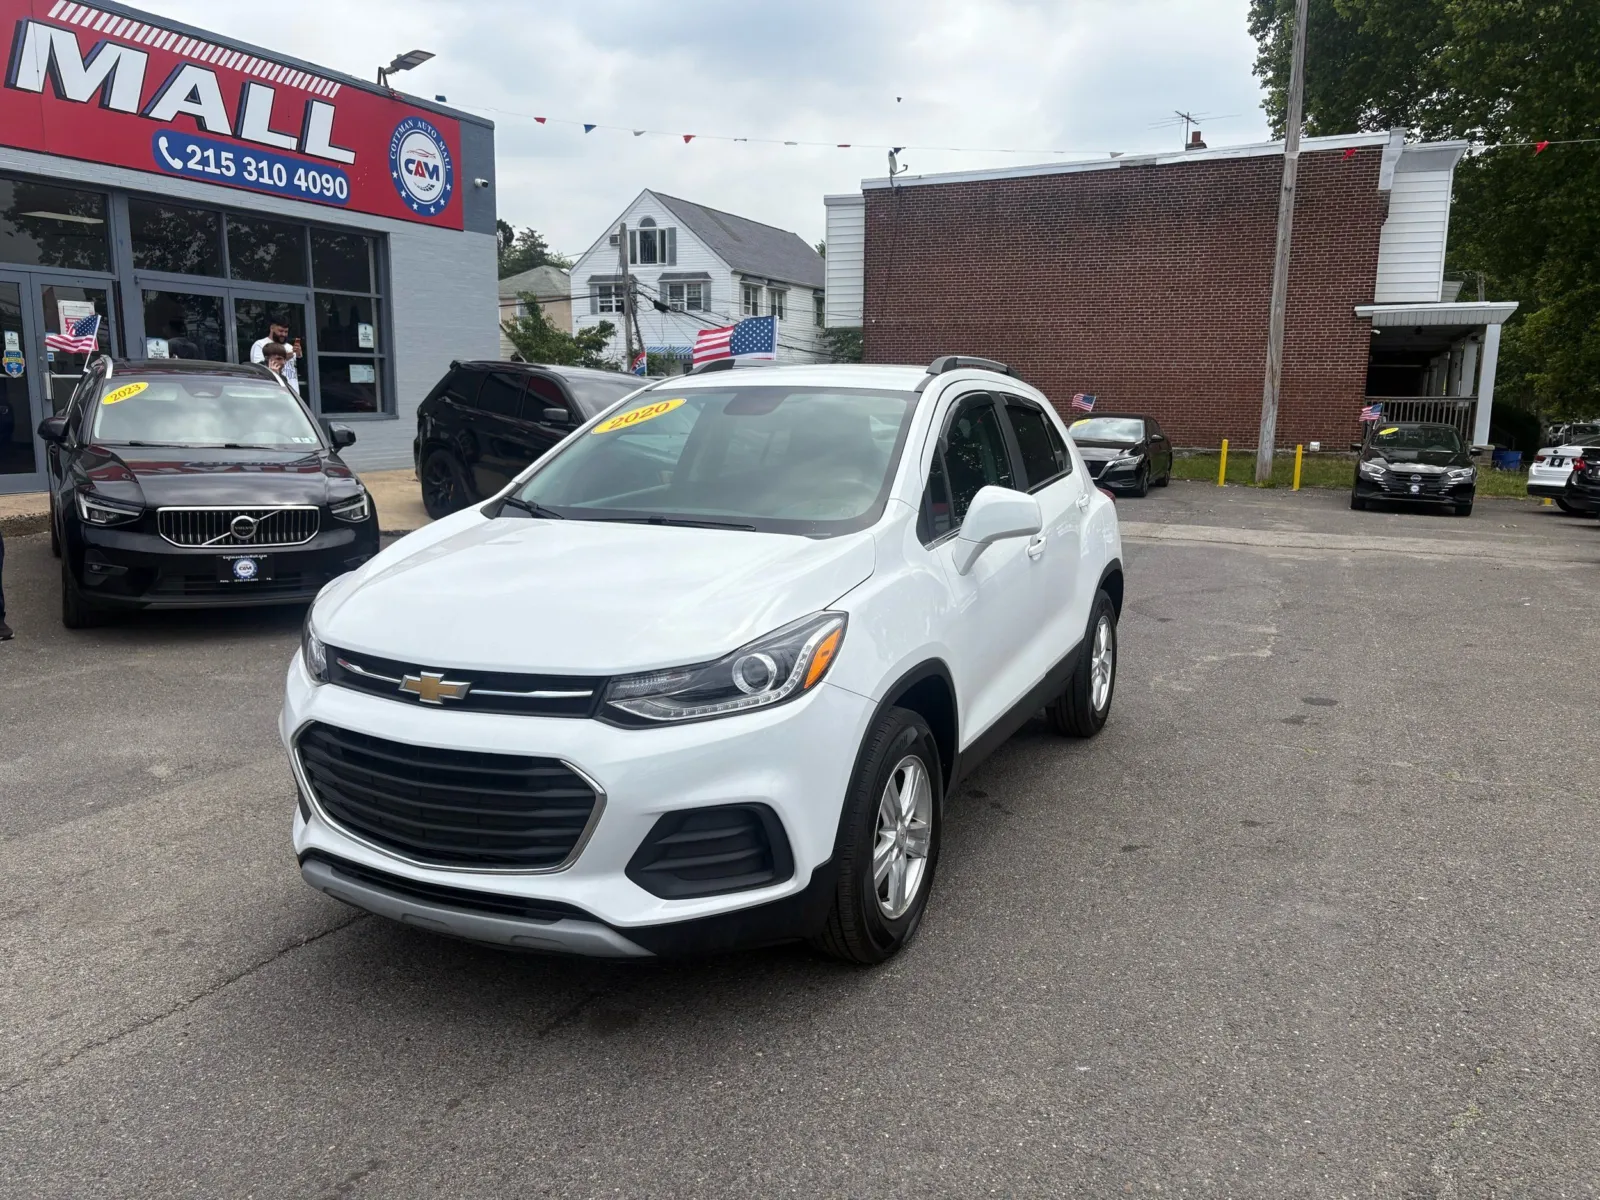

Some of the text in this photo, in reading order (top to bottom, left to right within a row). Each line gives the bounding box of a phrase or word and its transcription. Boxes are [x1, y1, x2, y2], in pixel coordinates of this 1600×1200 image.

[4, 18, 356, 165] MALL
[390, 120, 451, 171] COTTMAN AUTO MALL
[186, 144, 348, 200] 215 310 4090
[404, 158, 440, 182] CAM
[110, 384, 141, 401] 2023
[608, 402, 670, 430] 2020
